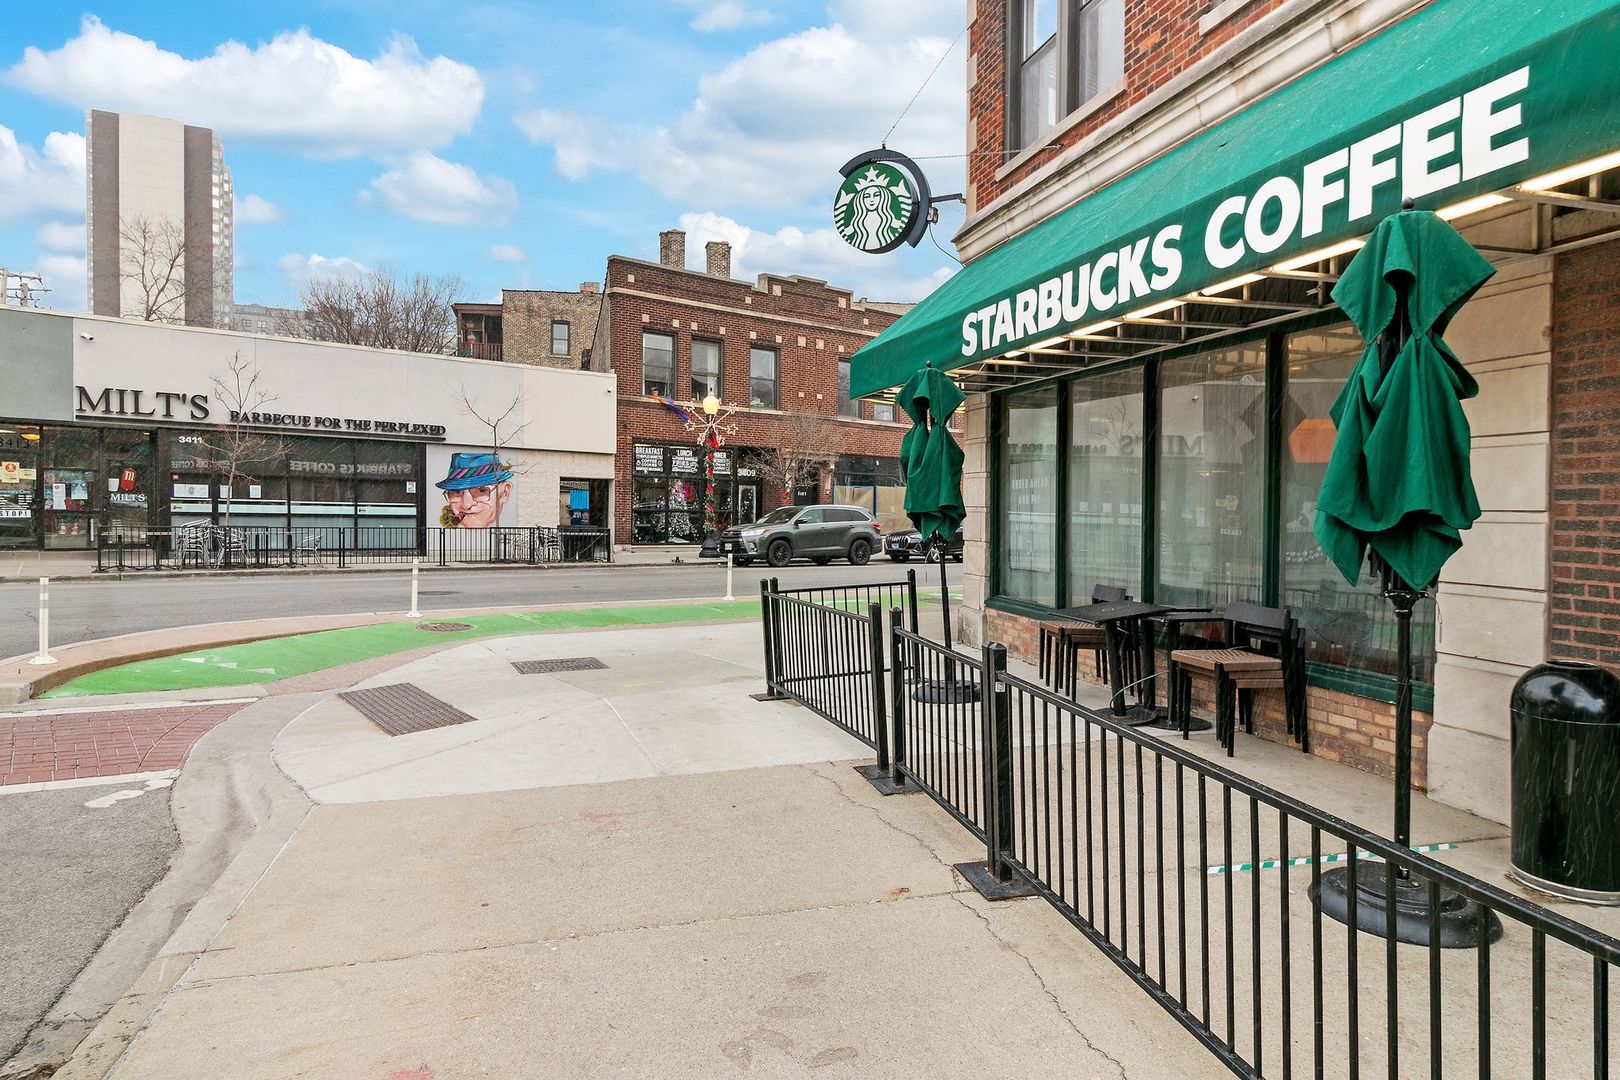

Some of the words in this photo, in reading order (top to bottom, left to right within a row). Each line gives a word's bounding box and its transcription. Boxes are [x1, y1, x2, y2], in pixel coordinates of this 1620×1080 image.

[961, 224, 1183, 357] STARBUCKS
[1204, 66, 1530, 269] COFFEE
[75, 385, 210, 420] MILT'S
[229, 410, 312, 428] BARBECUE
[314, 416, 342, 429] FOR
[344, 418, 371, 431] THE
[374, 420, 446, 436] PERPLEXED
[178, 435, 202, 444] 3411
[635, 447, 663, 455] BREAKFAST
[677, 449, 693, 457] LUNCH
